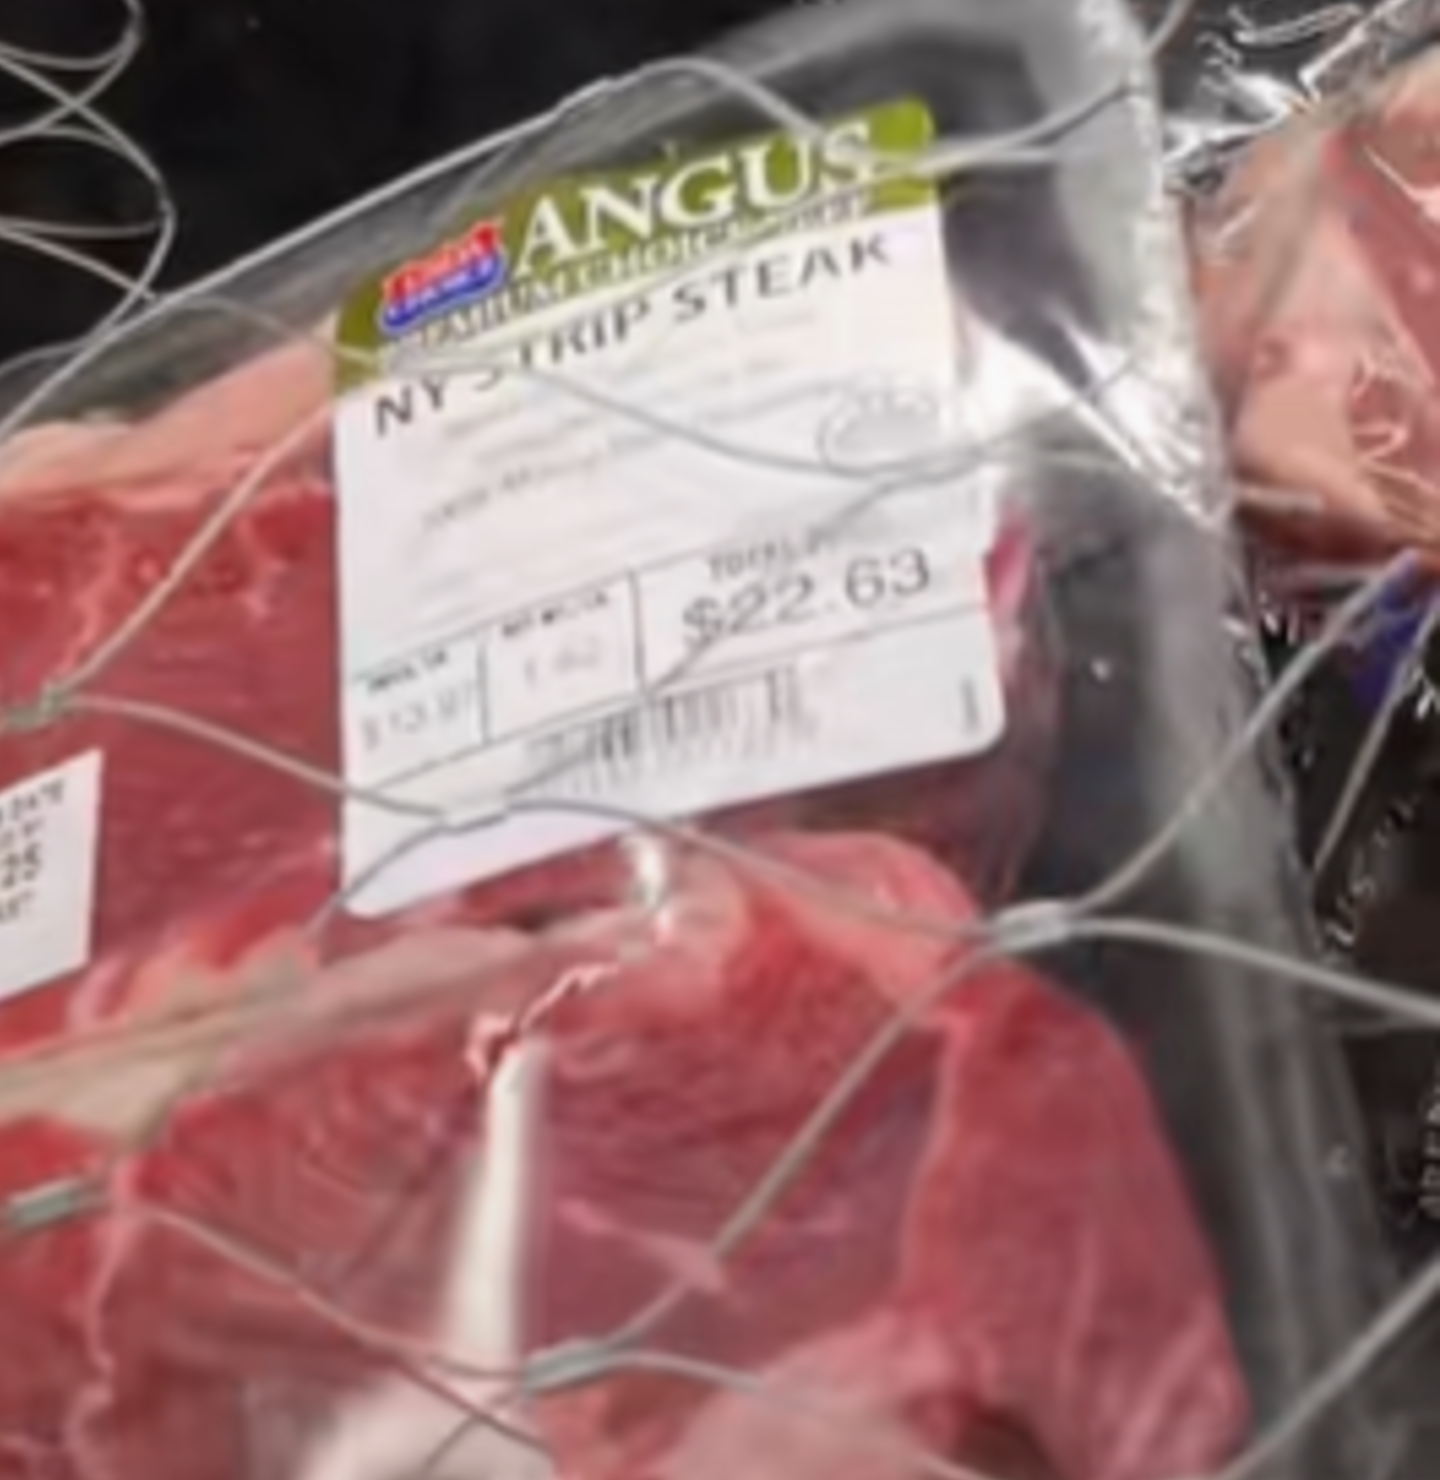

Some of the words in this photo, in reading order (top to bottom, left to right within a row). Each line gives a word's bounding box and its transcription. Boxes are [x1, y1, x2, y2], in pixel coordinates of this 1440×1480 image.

[513, 121, 873, 279] ANGUS
[374, 372, 448, 437] NY
[672, 231, 893, 326] STEAK
[681, 547, 930, 644] $22.63
